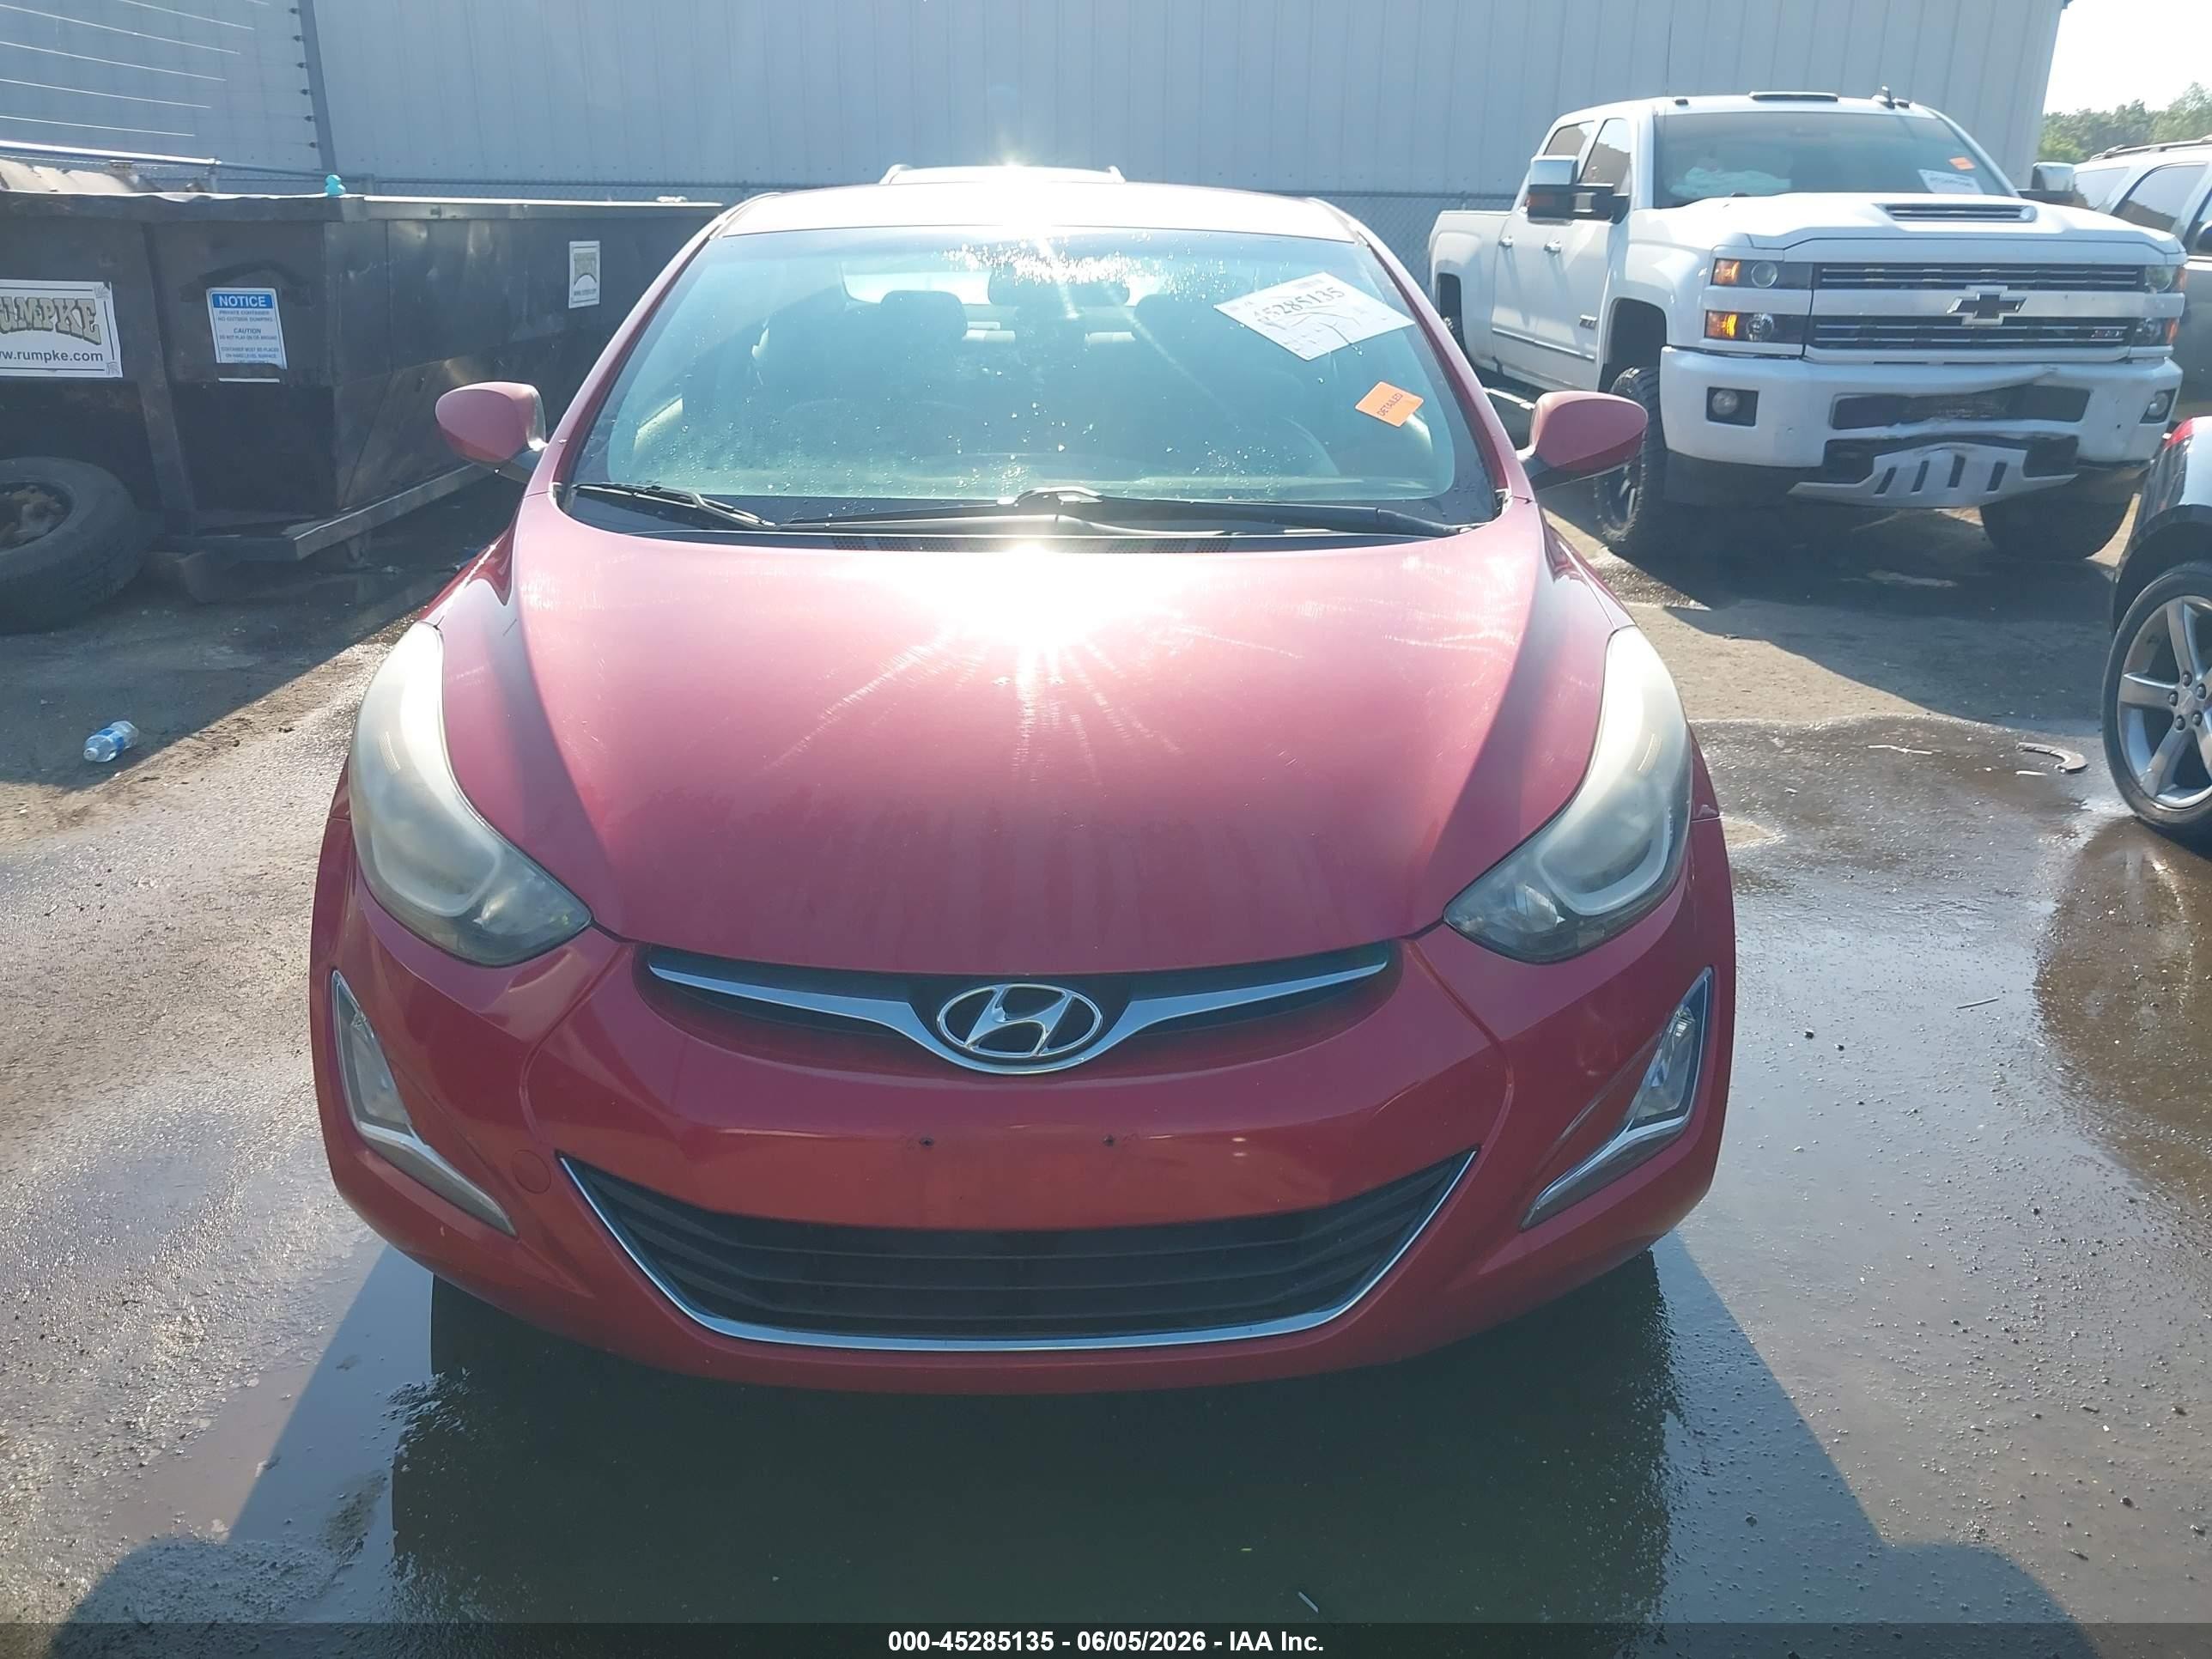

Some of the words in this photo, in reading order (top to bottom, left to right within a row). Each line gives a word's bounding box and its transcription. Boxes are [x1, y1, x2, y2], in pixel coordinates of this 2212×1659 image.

[219, 295, 267, 307] NOTICE
[0, 296, 101, 345] UMPKE
[0, 349, 103, 363] w.rumpke.com
[1376, 392, 1403, 416] DETAILED
